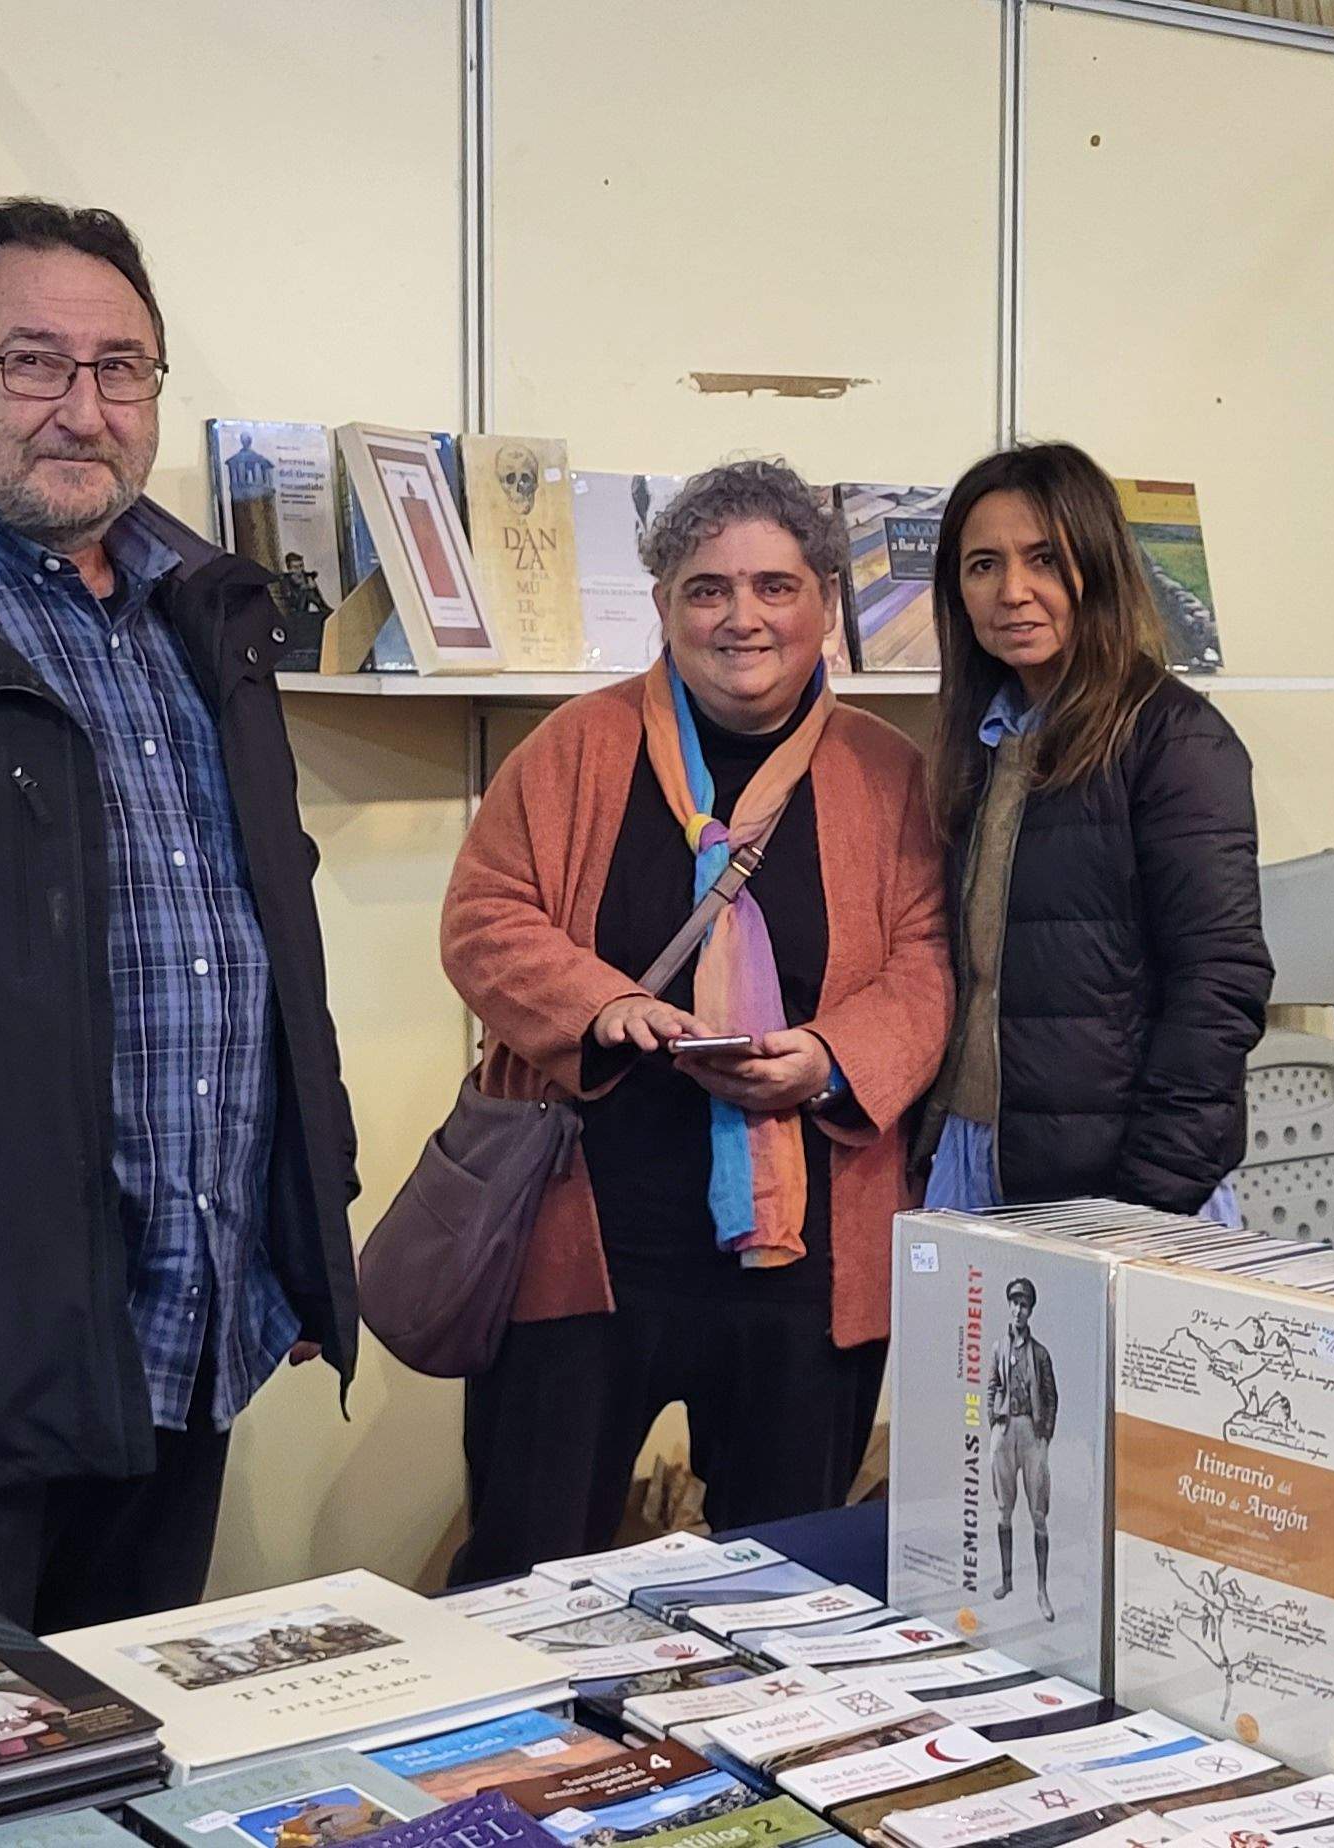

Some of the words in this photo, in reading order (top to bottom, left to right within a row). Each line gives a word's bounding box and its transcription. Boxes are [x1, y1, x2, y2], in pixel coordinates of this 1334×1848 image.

[966, 1263, 984, 1385] ROBERT
[964, 1392, 982, 1428] DE
[1194, 1448, 1275, 1491] Itinerario
[961, 1432, 982, 1593] MEMORIAS
[1177, 1474, 1227, 1505] Reino
[1243, 1493, 1310, 1533] Aragón
[649, 1753, 673, 1770] 4
[752, 1818, 783, 1835] 2
